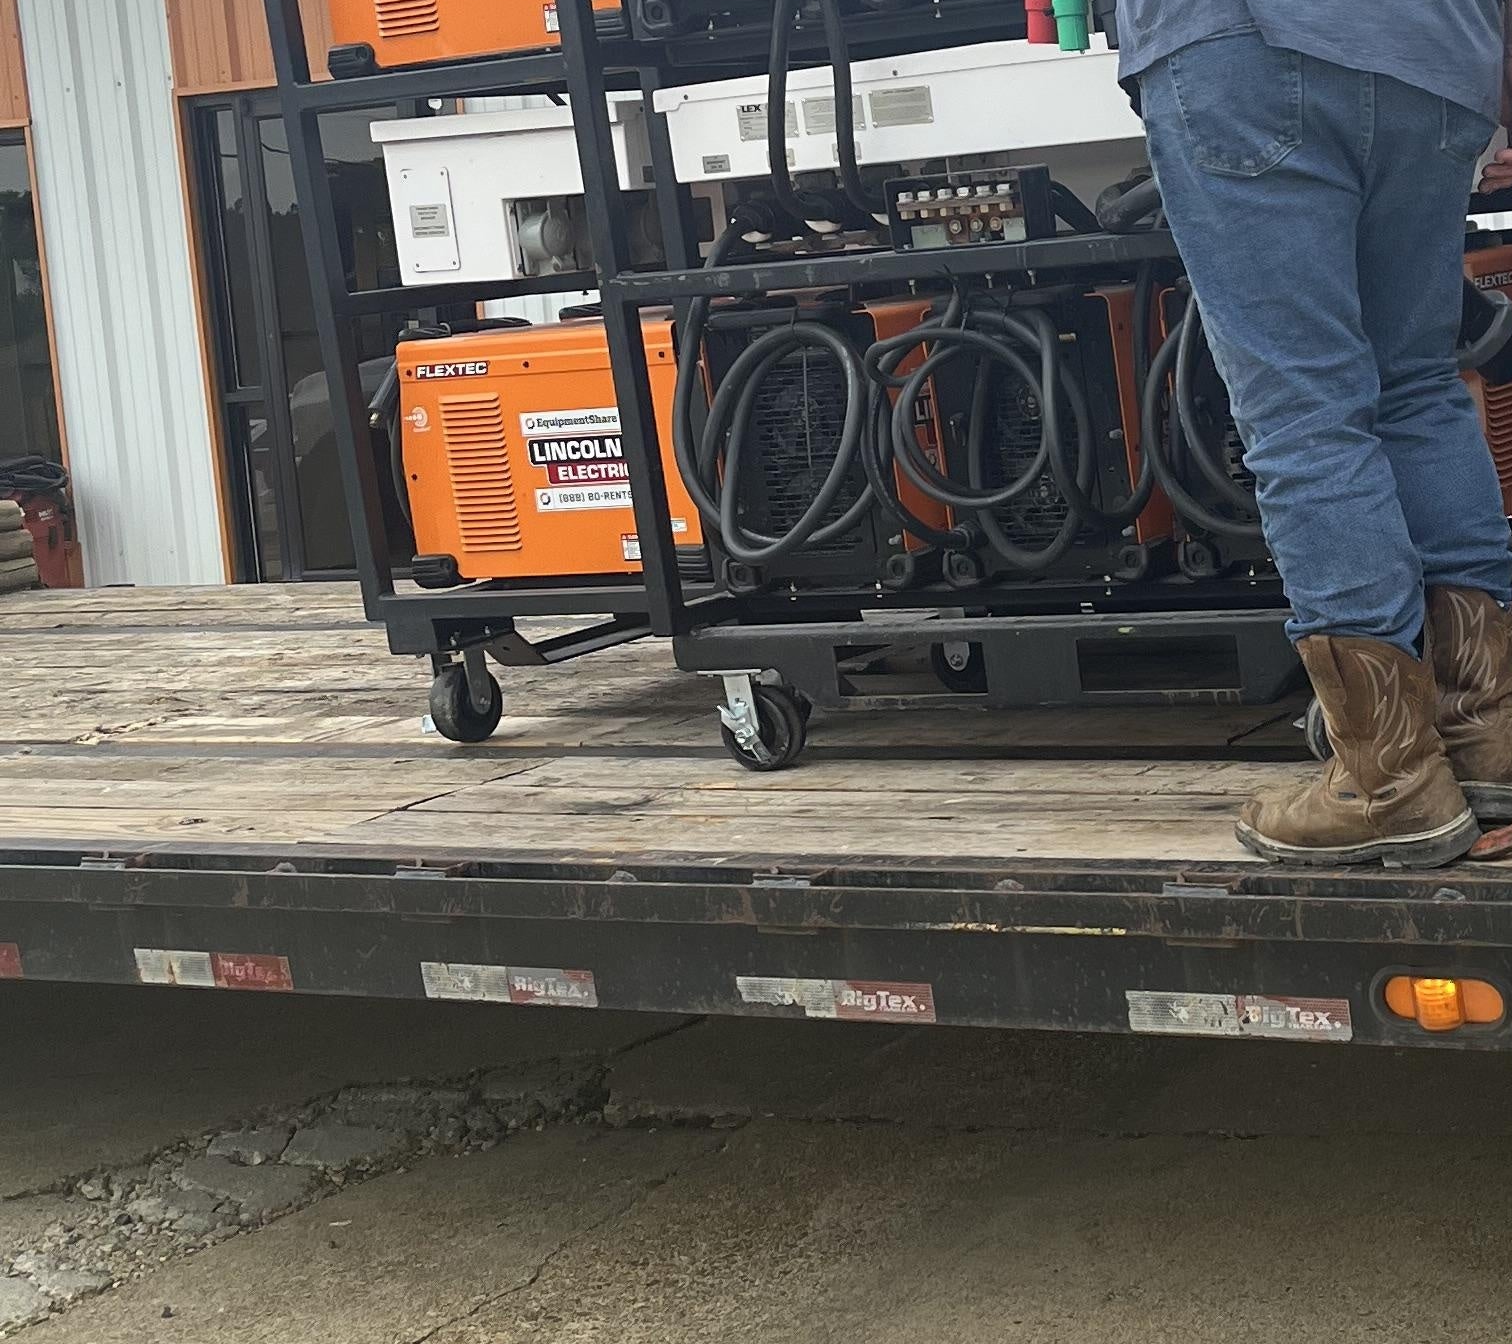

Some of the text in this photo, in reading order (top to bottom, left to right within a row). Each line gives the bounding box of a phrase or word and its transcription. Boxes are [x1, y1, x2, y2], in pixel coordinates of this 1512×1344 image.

[741, 104, 761, 113] LEX
[417, 362, 487, 378] FLEXTEC
[536, 414, 617, 430] EquipmentShare
[532, 438, 623, 462] LINCOLN
